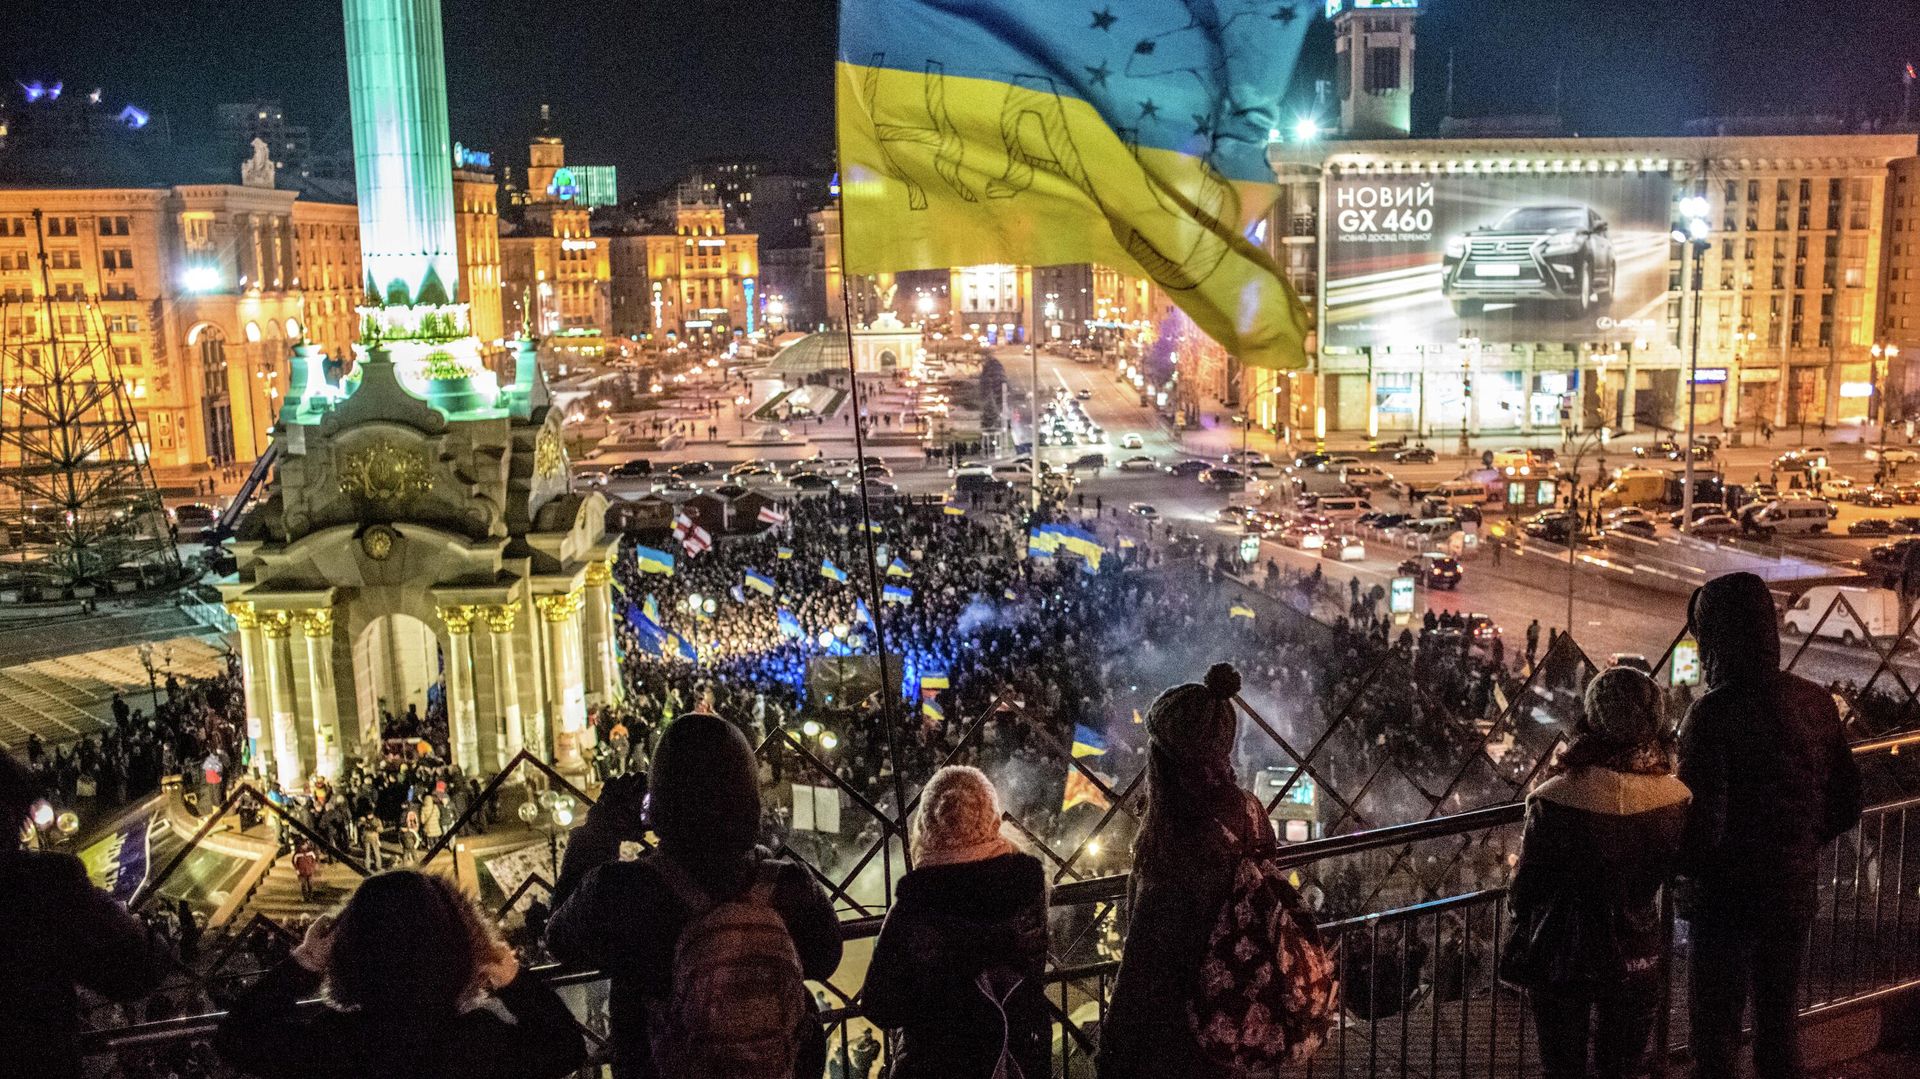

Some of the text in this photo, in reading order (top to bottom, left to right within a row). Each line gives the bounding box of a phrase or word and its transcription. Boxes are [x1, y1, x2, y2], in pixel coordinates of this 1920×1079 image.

[1337, 182, 1434, 208] НОВИЙ
[1338, 208, 1433, 232] GX 460
